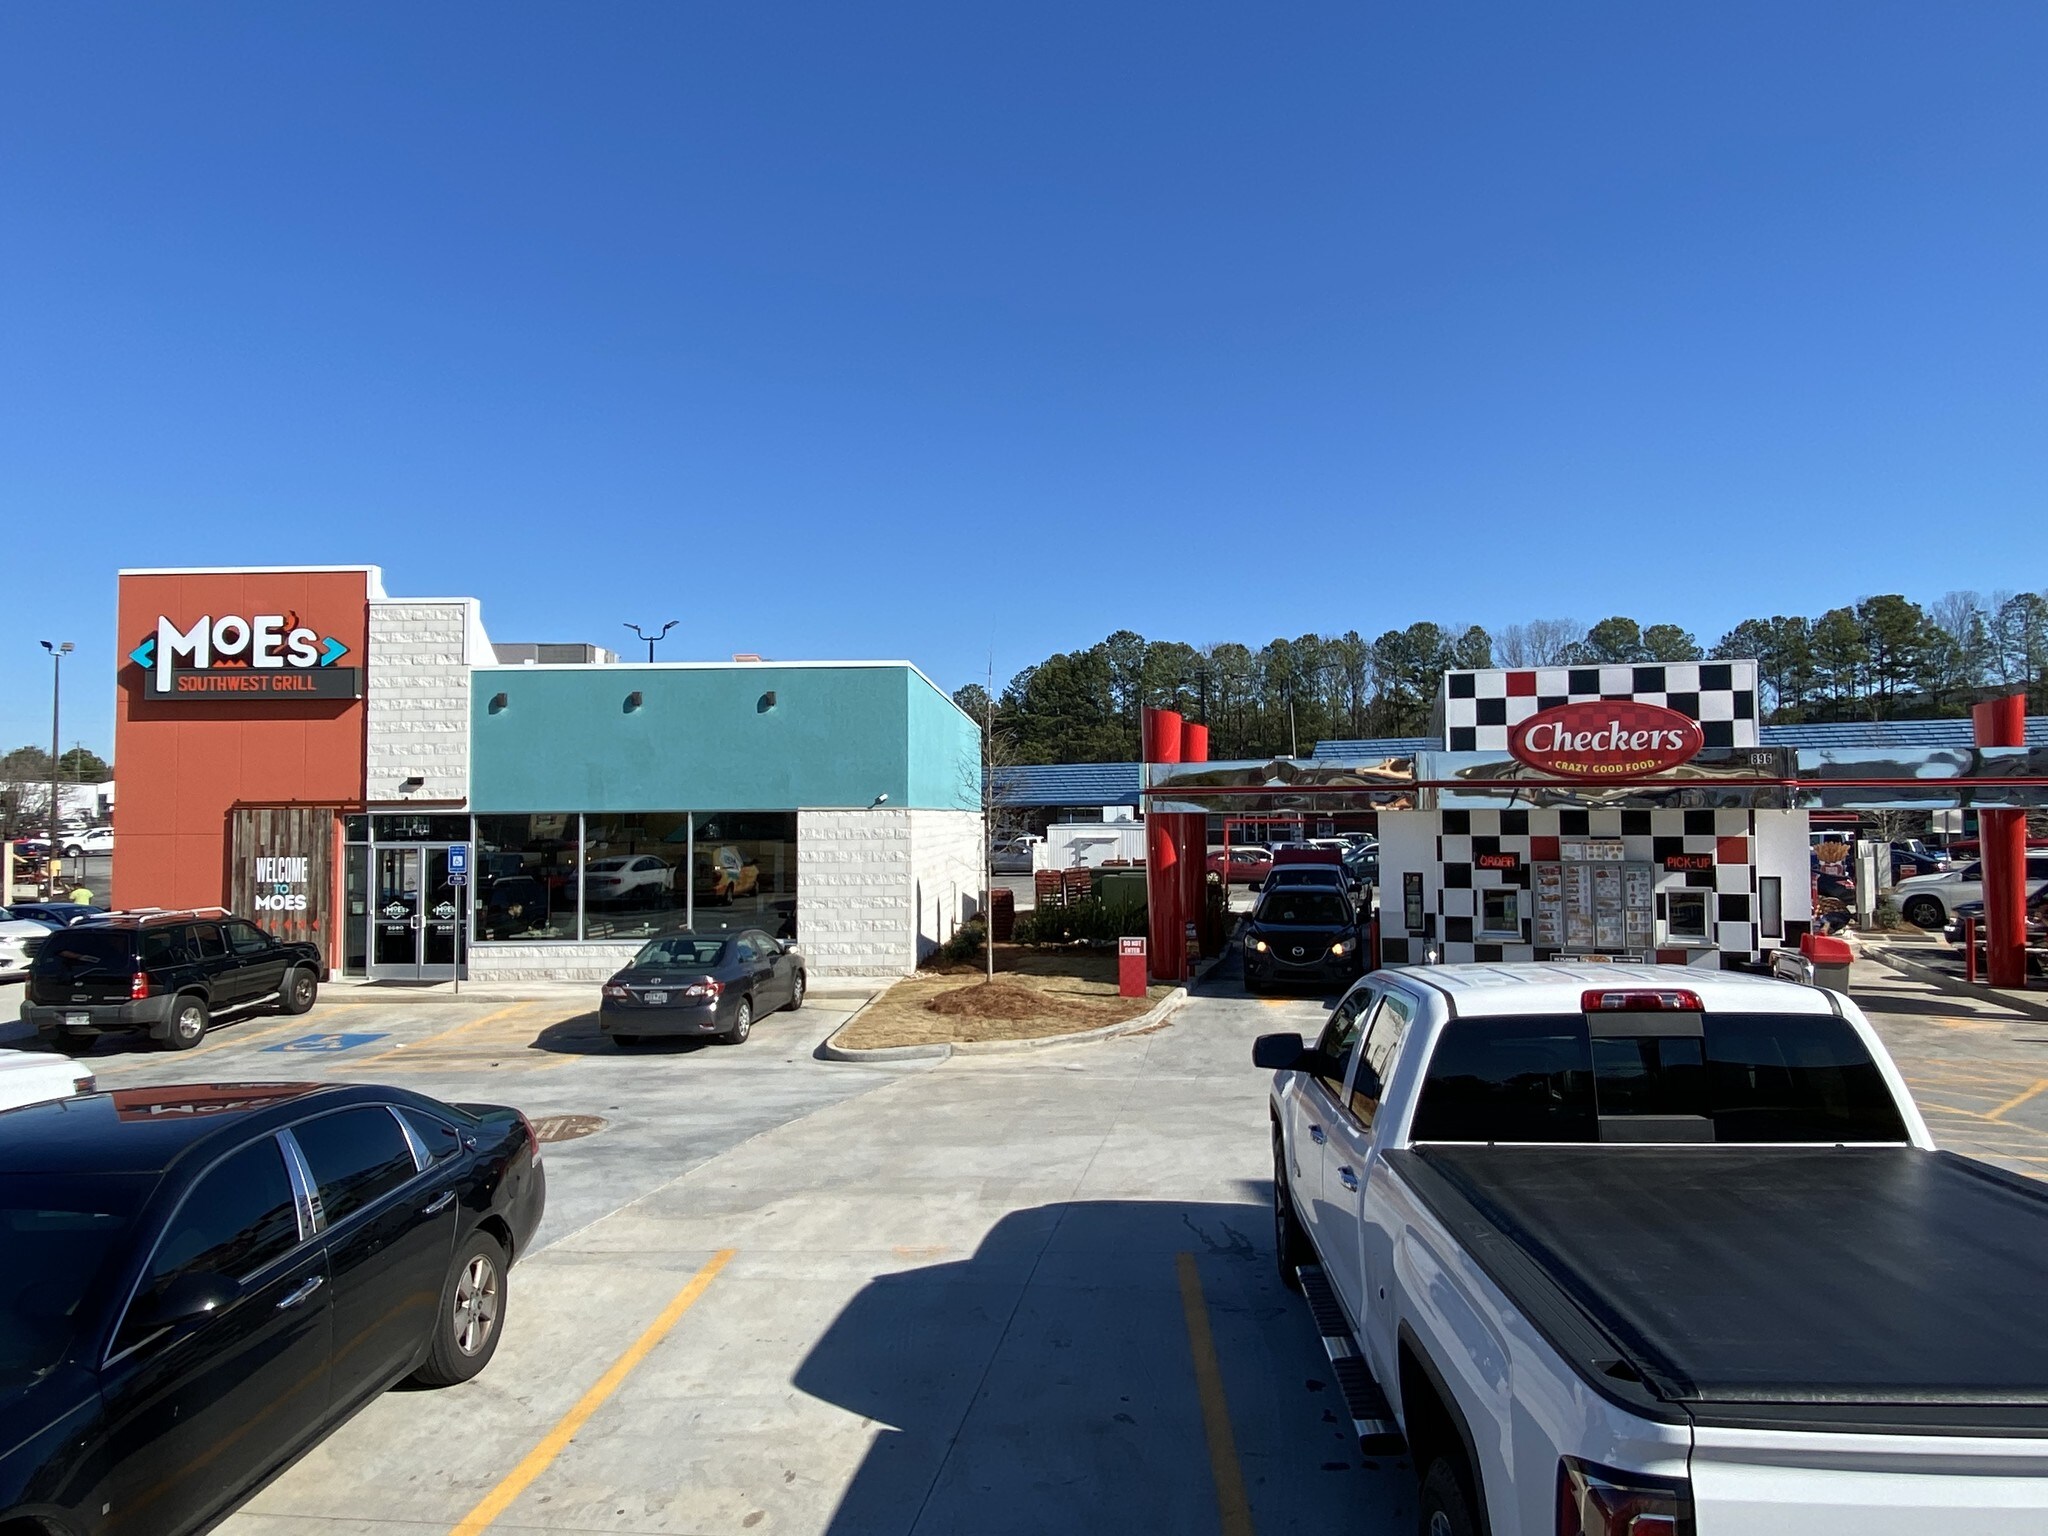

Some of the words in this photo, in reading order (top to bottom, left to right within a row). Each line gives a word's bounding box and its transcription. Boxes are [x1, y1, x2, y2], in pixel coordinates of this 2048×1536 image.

[178, 675, 269, 692] SOUTHWEST
[272, 675, 317, 691] GRILL
[1524, 720, 1683, 753] Checkers
[1555, 760, 1588, 772] CRAZY
[1592, 763, 1623, 773] GOOD
[1626, 759, 1655, 772] FOOD
[1752, 754, 1772, 764] 896
[1479, 855, 1515, 867] ORDER
[1666, 856, 1711, 868] PICK-UP
[256, 857, 308, 883] WELCOME
[273, 883, 289, 895] TO
[255, 895, 307, 911] MOES
